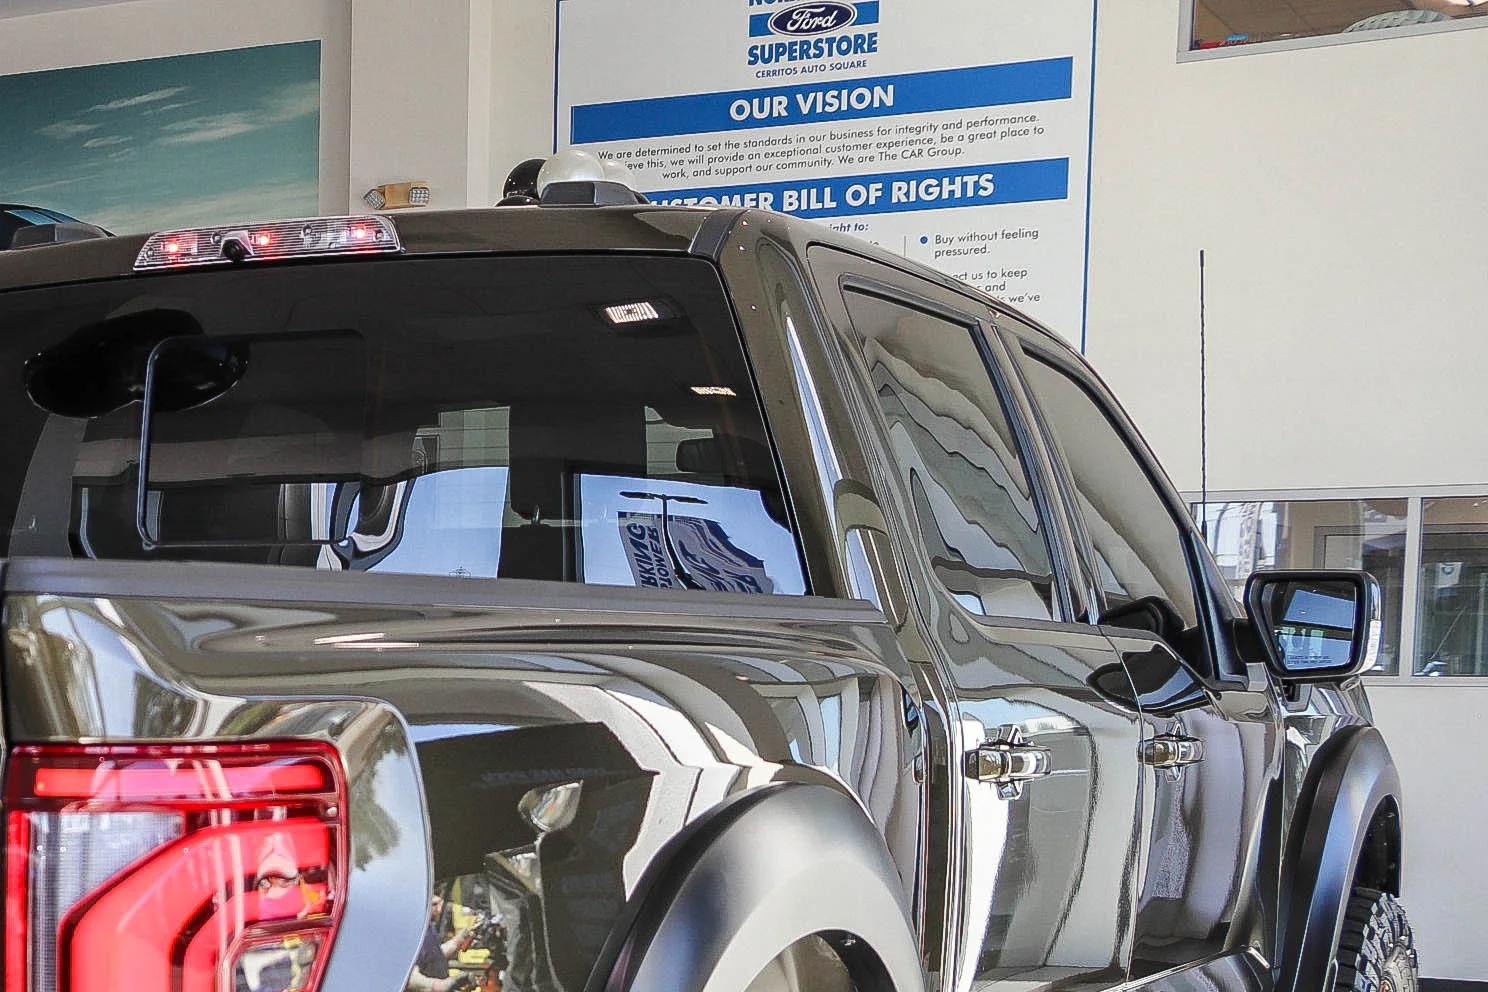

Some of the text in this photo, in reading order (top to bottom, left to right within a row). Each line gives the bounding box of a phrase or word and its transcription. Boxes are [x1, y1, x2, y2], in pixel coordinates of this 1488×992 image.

[786, 7, 838, 31] Ford
[747, 32, 878, 66] SUPERSTORE
[755, 59, 868, 79] CERRITOS AUTO SQUARE
[730, 84, 894, 121] OUR VISION
[598, 113, 1040, 160] We are determined to set the standards in our business for integrity and performance.
[647, 158, 667, 169] this,
[670, 158, 685, 167] we
[688, 155, 704, 165] will
[707, 152, 744, 167] provide
[748, 152, 761, 160] an
[764, 145, 822, 161] exceptional
[825, 141, 873, 154] customer
[876, 136, 937, 150] experience,
[940, 133, 954, 144] be
[958, 134, 965, 142] a
[968, 130, 997, 144] great
[1000, 128, 1030, 143] place
[1033, 126, 1044, 136] to
[662, 147, 965, 180] work, and support our community. We are The CAR Group.
[783, 187, 837, 212] BILL
[845, 183, 883, 207] OF
[891, 173, 995, 204] RIGHTS
[935, 228, 1039, 246] Buy without feeling
[934, 244, 990, 259] pressured.
[972, 272, 983, 280] us
[987, 270, 997, 279] to
[1001, 268, 1028, 280] keep
[985, 281, 1006, 292] and
[1009, 292, 1041, 303] we've
